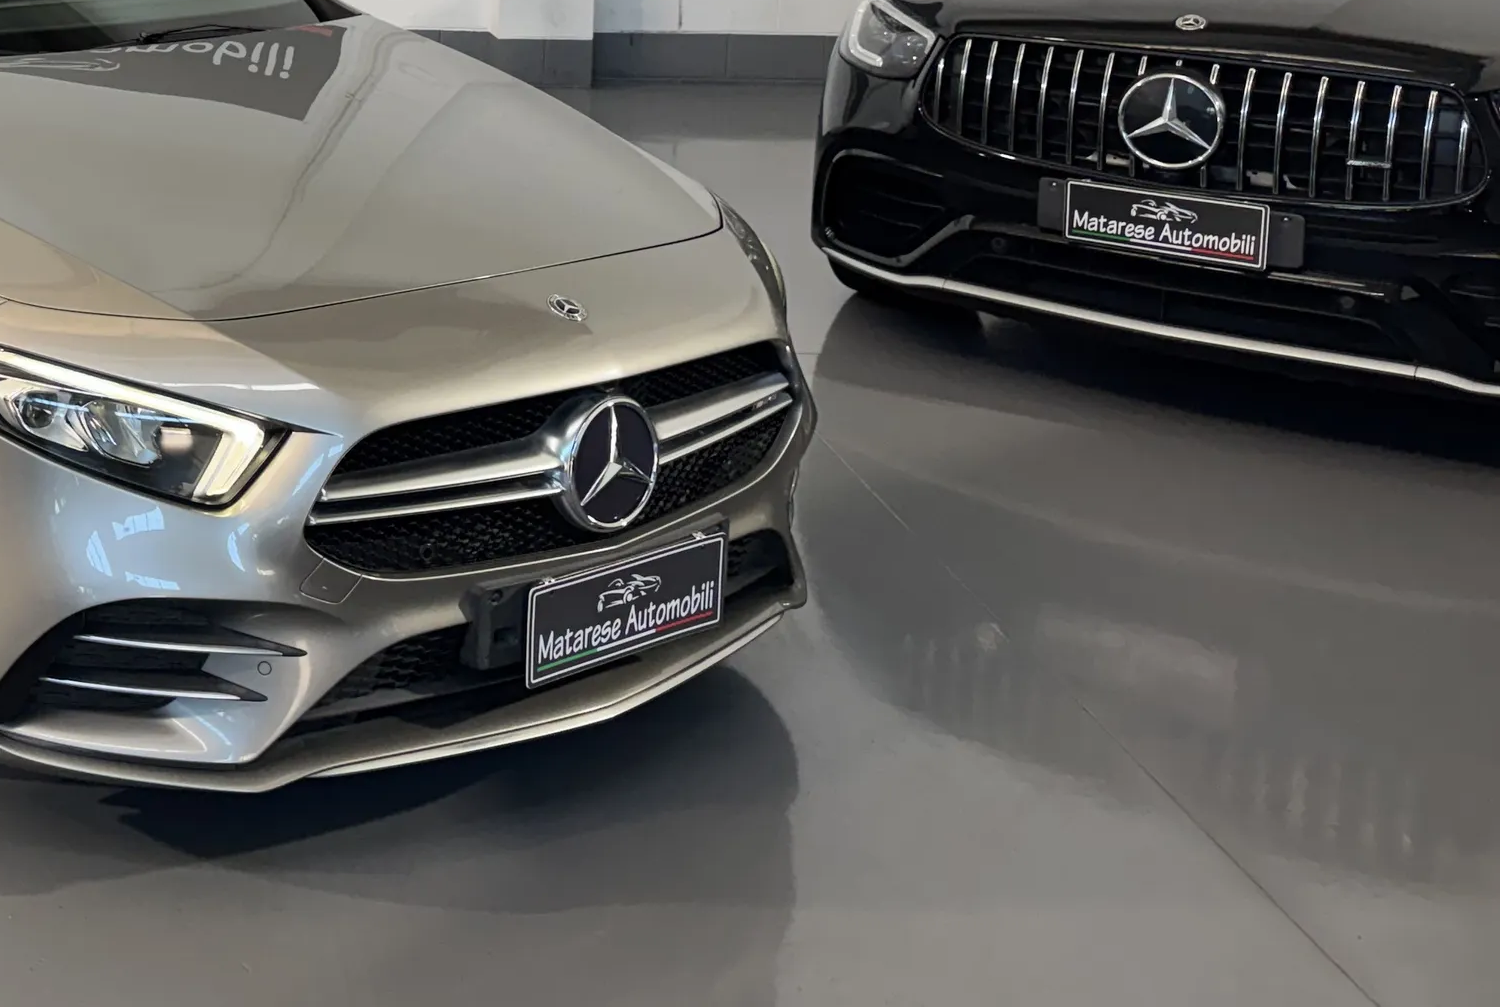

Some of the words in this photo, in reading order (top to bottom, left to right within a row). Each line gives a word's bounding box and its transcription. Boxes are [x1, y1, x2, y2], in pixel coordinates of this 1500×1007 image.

[1073, 209, 1155, 241] Matarese
[1159, 223, 1256, 256] Automobili
[537, 620, 622, 665] Matarese
[625, 580, 715, 635] Automobili
